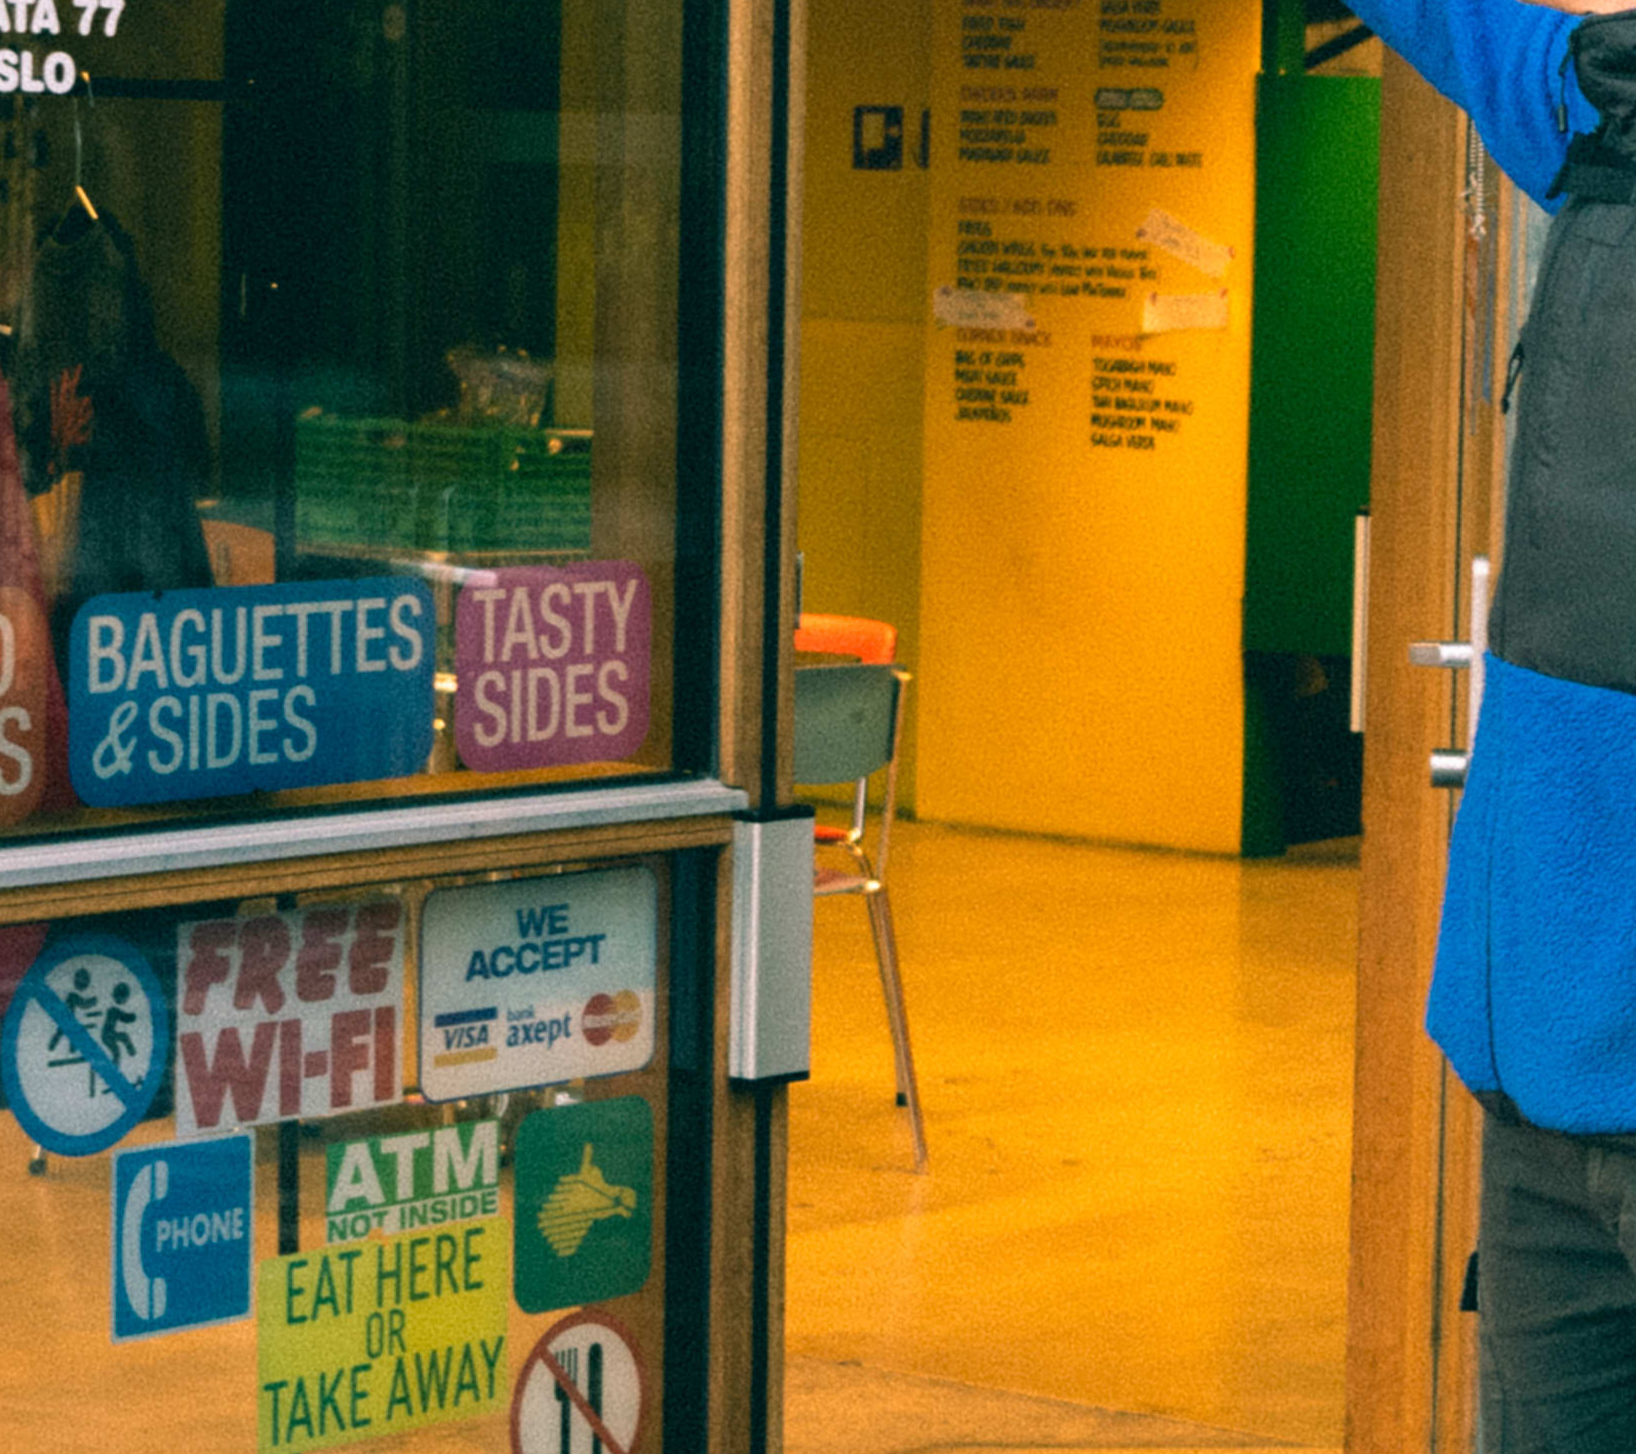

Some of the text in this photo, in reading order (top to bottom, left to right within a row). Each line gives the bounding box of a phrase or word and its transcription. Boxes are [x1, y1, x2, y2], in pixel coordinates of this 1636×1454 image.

[87, 594, 422, 694] BAGUETTES
[474, 579, 637, 664] TASTY
[474, 660, 629, 747] SIDES
[516, 903, 569, 938] WE
[182, 902, 402, 1016] FREE
[465, 934, 606, 982] ACCEPT
[444, 1024, 490, 1050] VISA
[506, 1005, 535, 1022] bank
[506, 1010, 572, 1050] axept
[180, 1006, 396, 1128] WI-FI
[328, 1120, 500, 1213] ATM
[157, 1207, 245, 1252] PHONE
[327, 1191, 498, 1243] NOT INSIDE
[287, 1227, 485, 1325] EAT HERE
[366, 1309, 406, 1359] OR
[264, 1324, 504, 1446] TAKE AWAY
